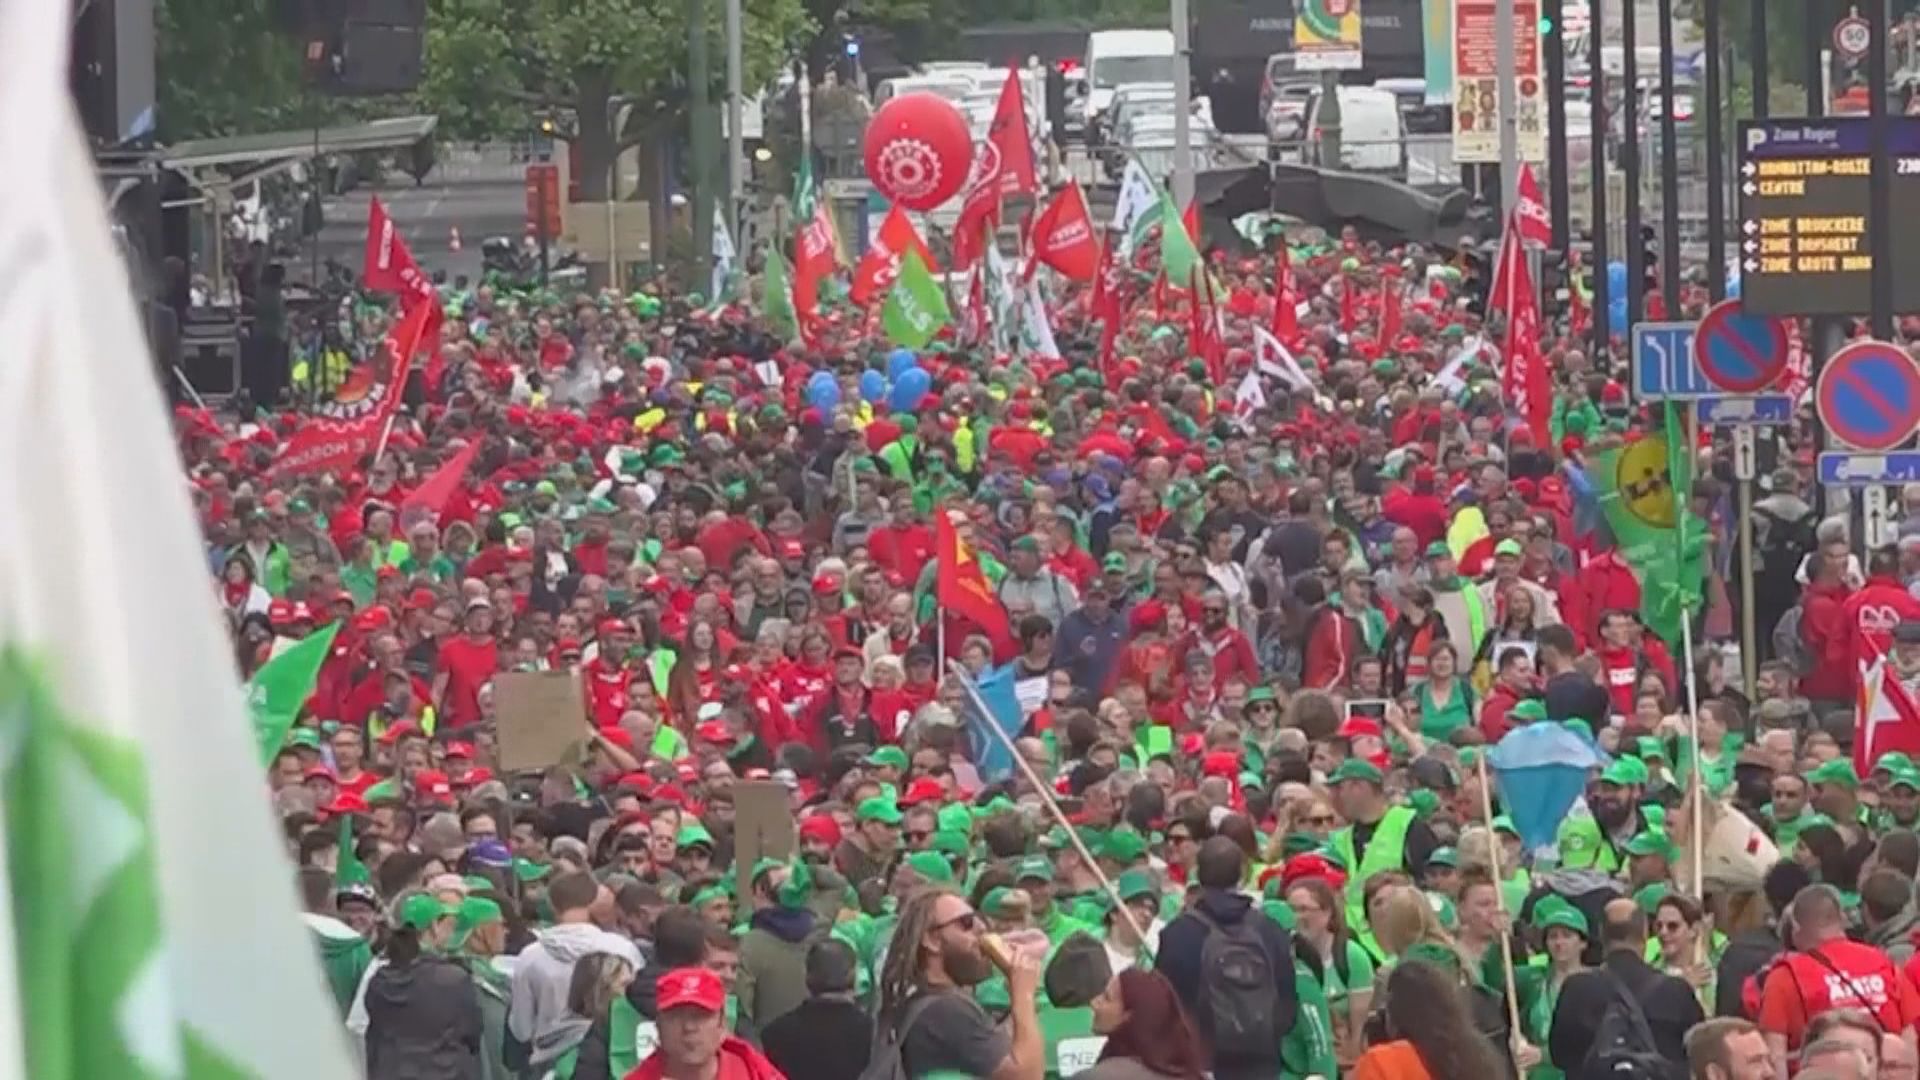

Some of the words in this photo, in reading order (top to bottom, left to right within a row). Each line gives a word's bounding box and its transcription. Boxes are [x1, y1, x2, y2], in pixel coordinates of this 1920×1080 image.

[1773, 128, 1799, 142] Zone
[1760, 180, 1805, 195] CENTRE
[1761, 218, 1790, 233] ZONE
[1761, 238, 1790, 253] ZONE
[1761, 257, 1791, 272] ZONE
